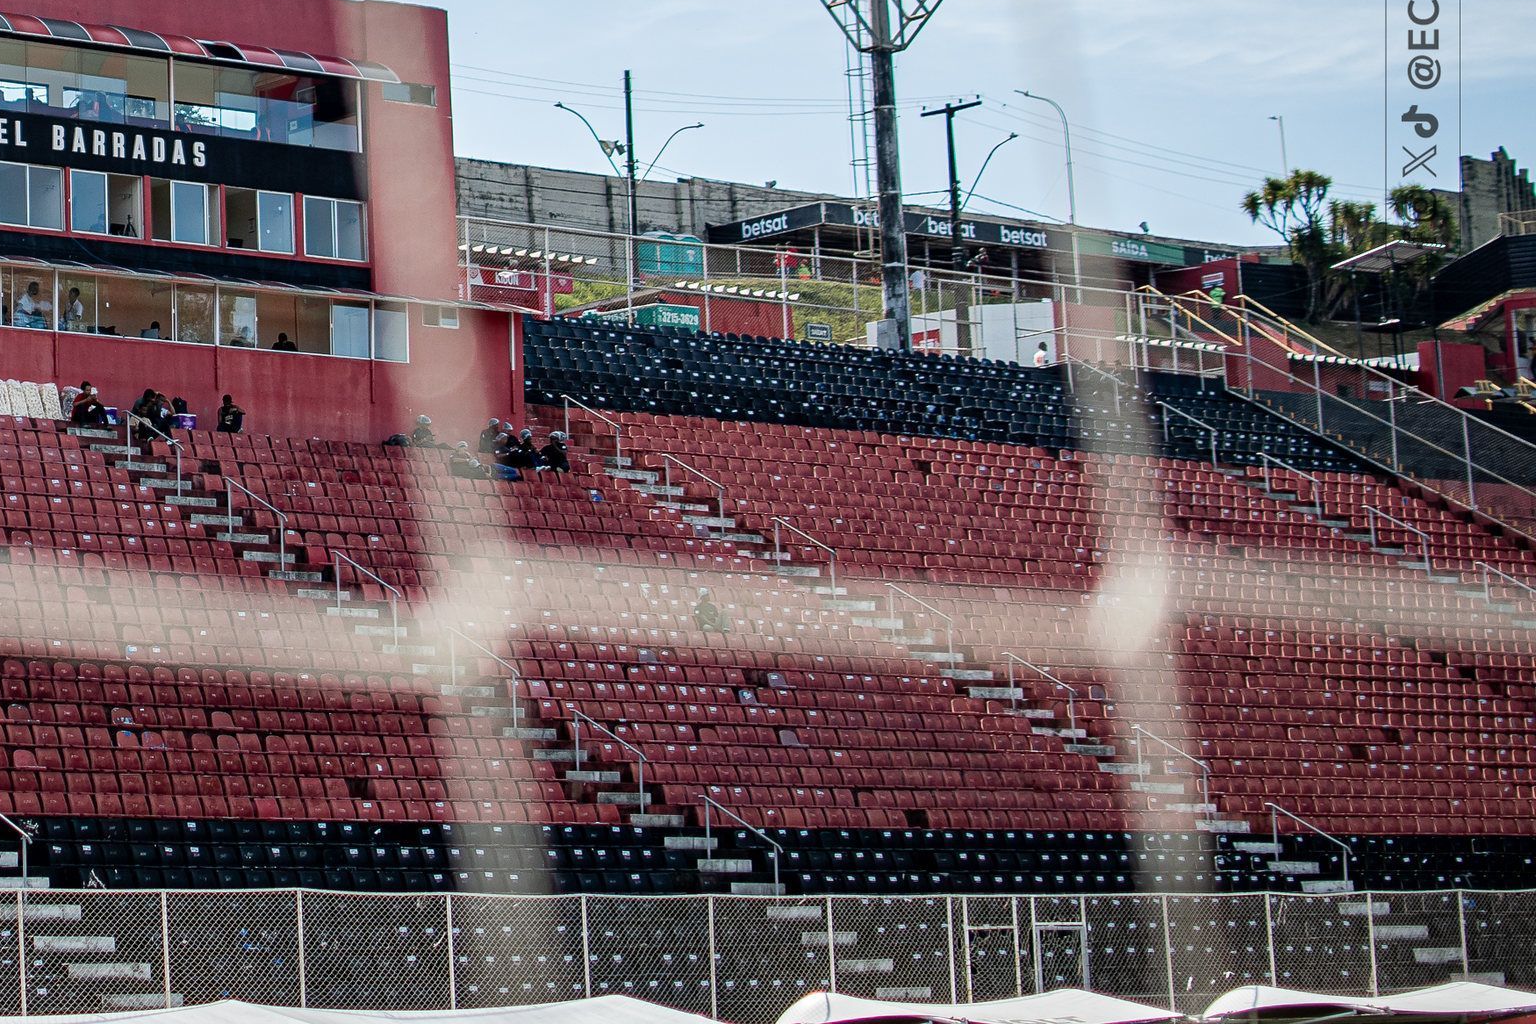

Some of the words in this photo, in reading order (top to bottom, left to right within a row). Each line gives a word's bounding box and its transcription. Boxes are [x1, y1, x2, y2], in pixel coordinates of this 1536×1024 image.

[52, 124, 206, 167] BARRADAS
[742, 213, 788, 238] betsat
[1000, 225, 1047, 247] betsat
[1112, 240, 1148, 256] SAÍDA
